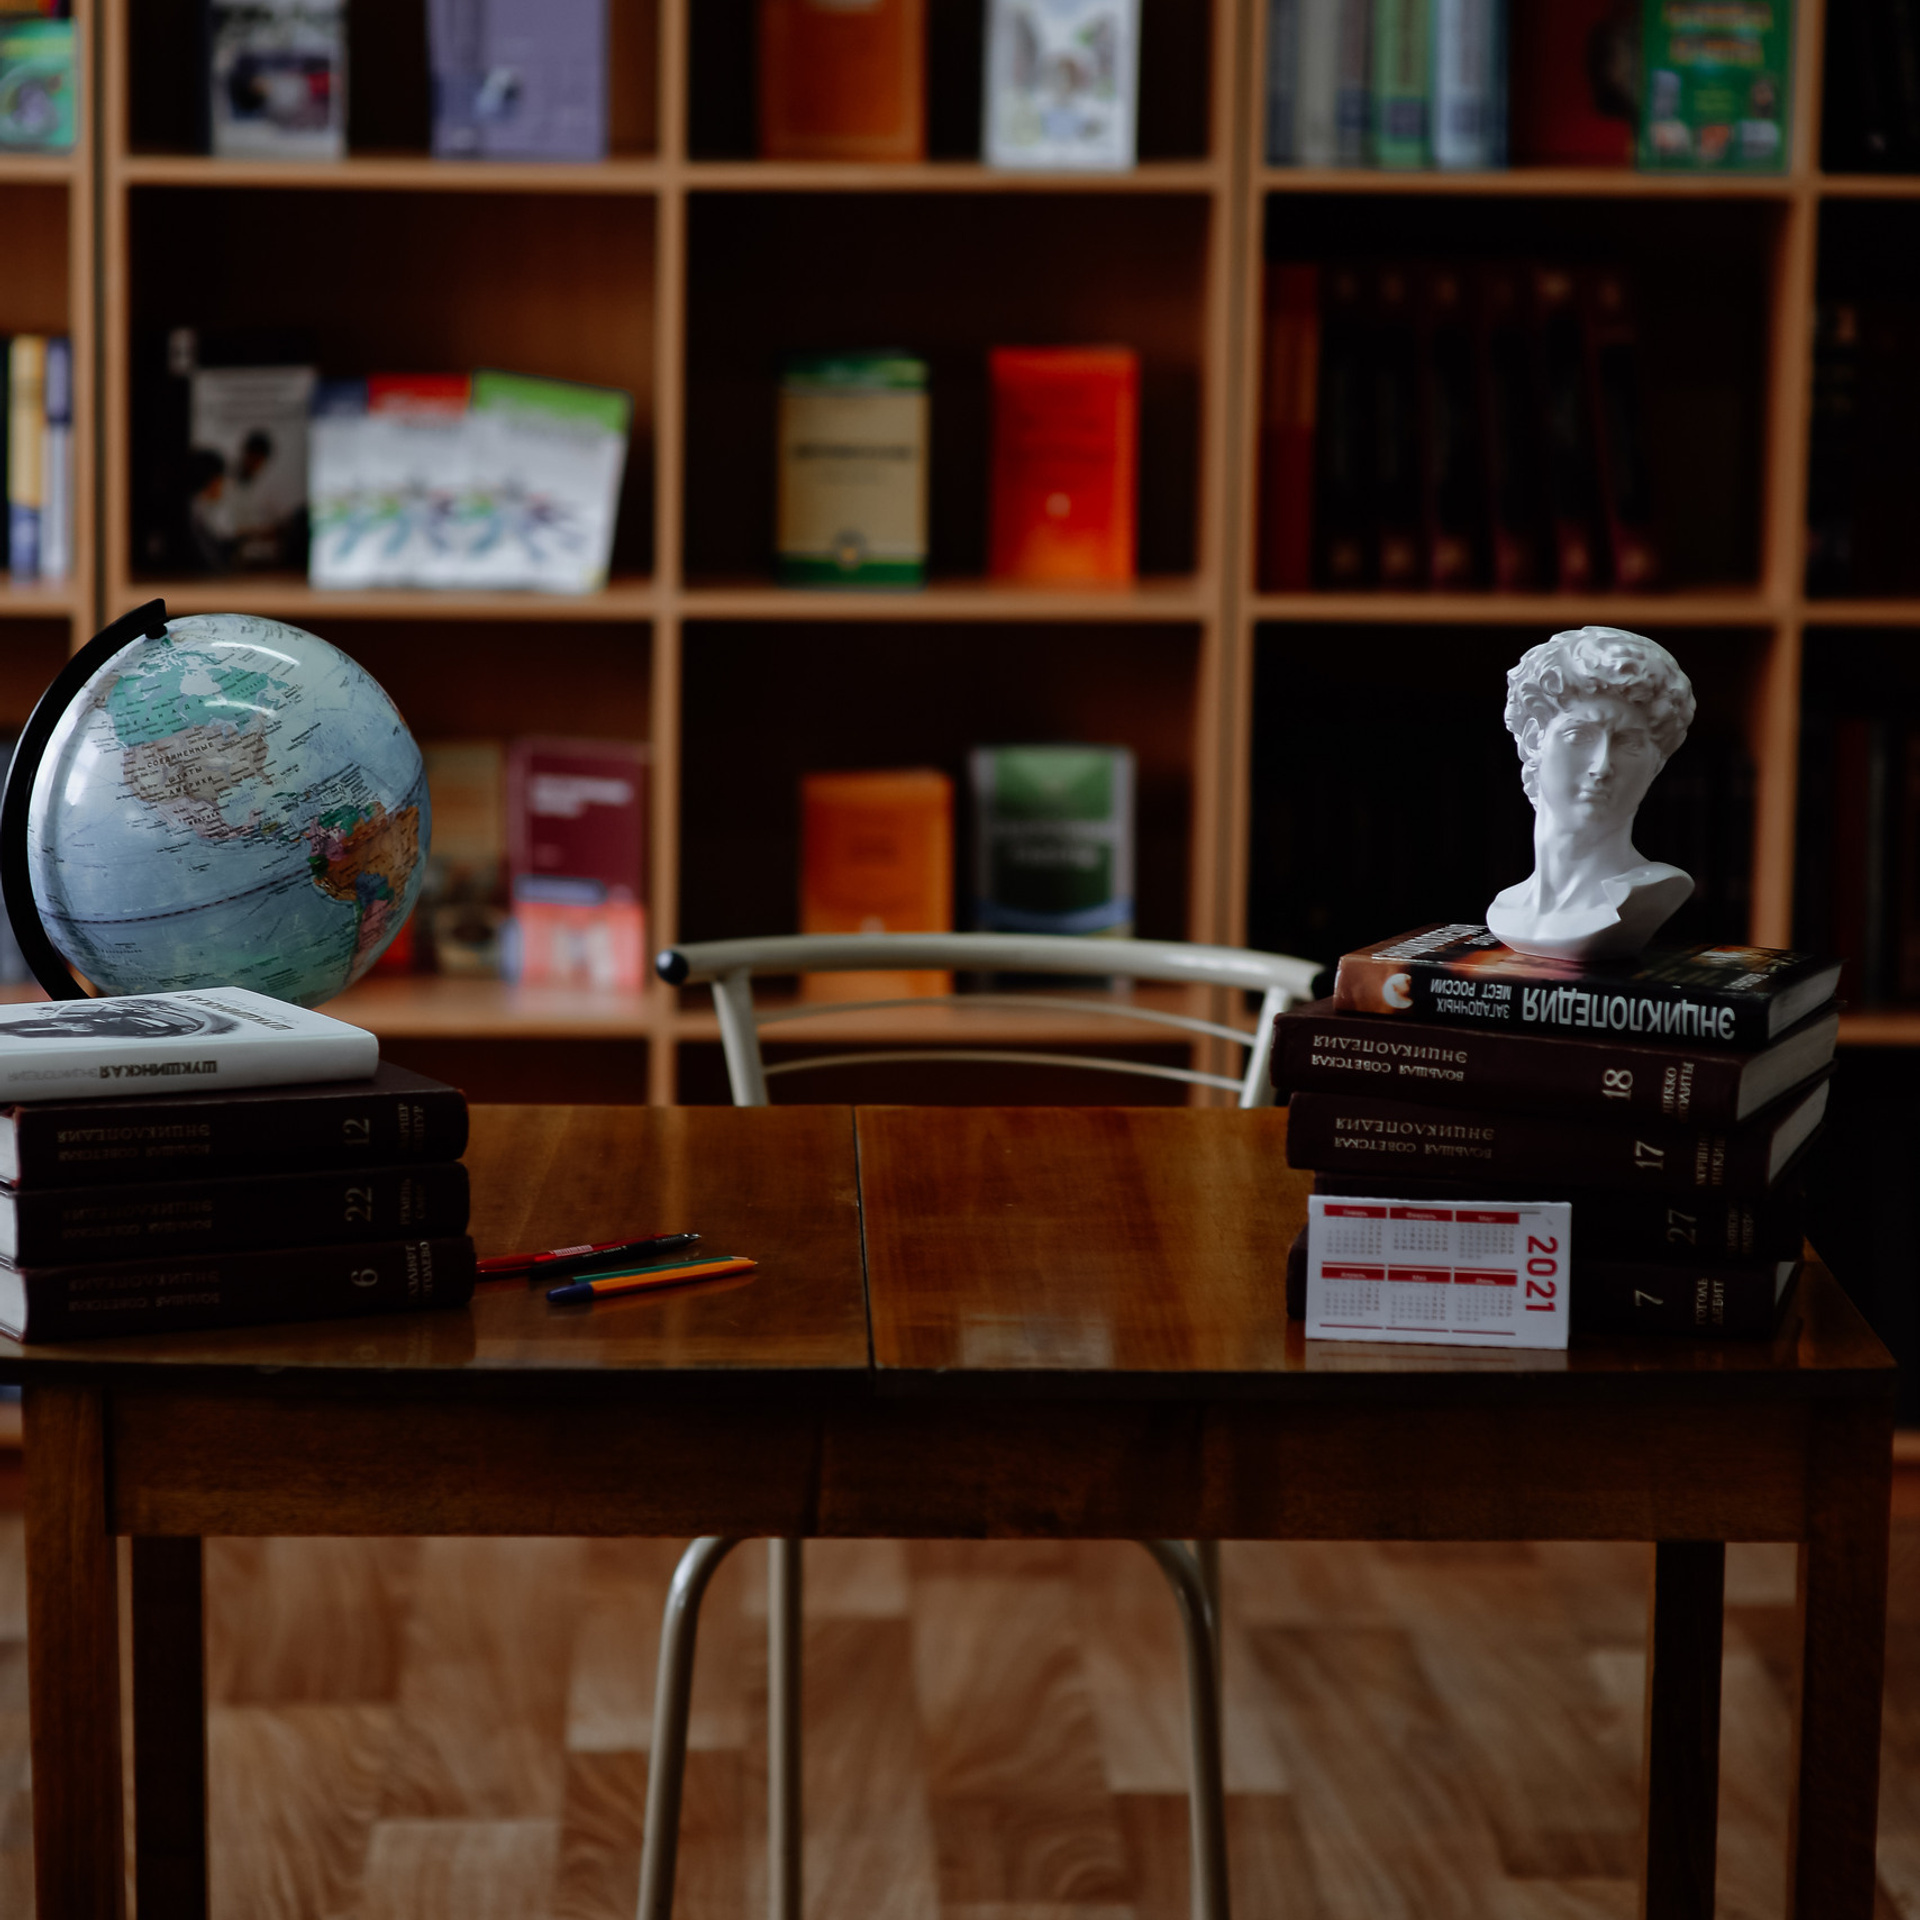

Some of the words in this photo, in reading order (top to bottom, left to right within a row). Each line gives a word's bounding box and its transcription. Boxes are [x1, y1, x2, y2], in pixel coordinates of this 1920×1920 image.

[1429, 977, 1476, 998] РОССИИ
[1482, 983, 1513, 1001] МЕСТ
[1436, 997, 1510, 1019] ЗАГАДОЧНЫХ
[1521, 985, 1736, 1041] ЭНЦИКЛОПЕДИЯ
[1311, 1034, 1468, 1064] ЭНЦИКЛОПЕДИЯ
[99, 1060, 217, 1079] ШУКШИНСКАЯ
[1310, 1053, 1392, 1074] СОВЕТСКАЯ
[1398, 1065, 1465, 1082] БОЛЬШАЯ
[1601, 1067, 1634, 1100] 18
[56, 1123, 211, 1143] ЭНЦИКЛОПЕДИЯ
[342, 1117, 371, 1146] 12
[1335, 1116, 1496, 1141] ЭНЦИКЛОПЕДИЯ
[57, 1147, 139, 1162] СОВЕТСКАЯ
[144, 1143, 210, 1157] БОЛЬШАЯ
[1332, 1136, 1417, 1154] СОВЕТСКАЯ
[1424, 1142, 1493, 1160] БОЛЬШАЯ
[1634, 1139, 1665, 1171] 17
[61, 1199, 213, 1220] ЭНЦИКЛОПЕДИЯ
[344, 1186, 373, 1222] 22
[1666, 1208, 1697, 1245] 27
[68, 1270, 220, 1292] ЭНЦИКЛОПЕДИЯ
[349, 1267, 379, 1288] 6
[1525, 1235, 1559, 1312] 2021
[68, 1297, 148, 1312] СОВЕТСКАЯ
[154, 1292, 220, 1307] БОЛЬШАЯ
[1633, 1288, 1664, 1308] 7
